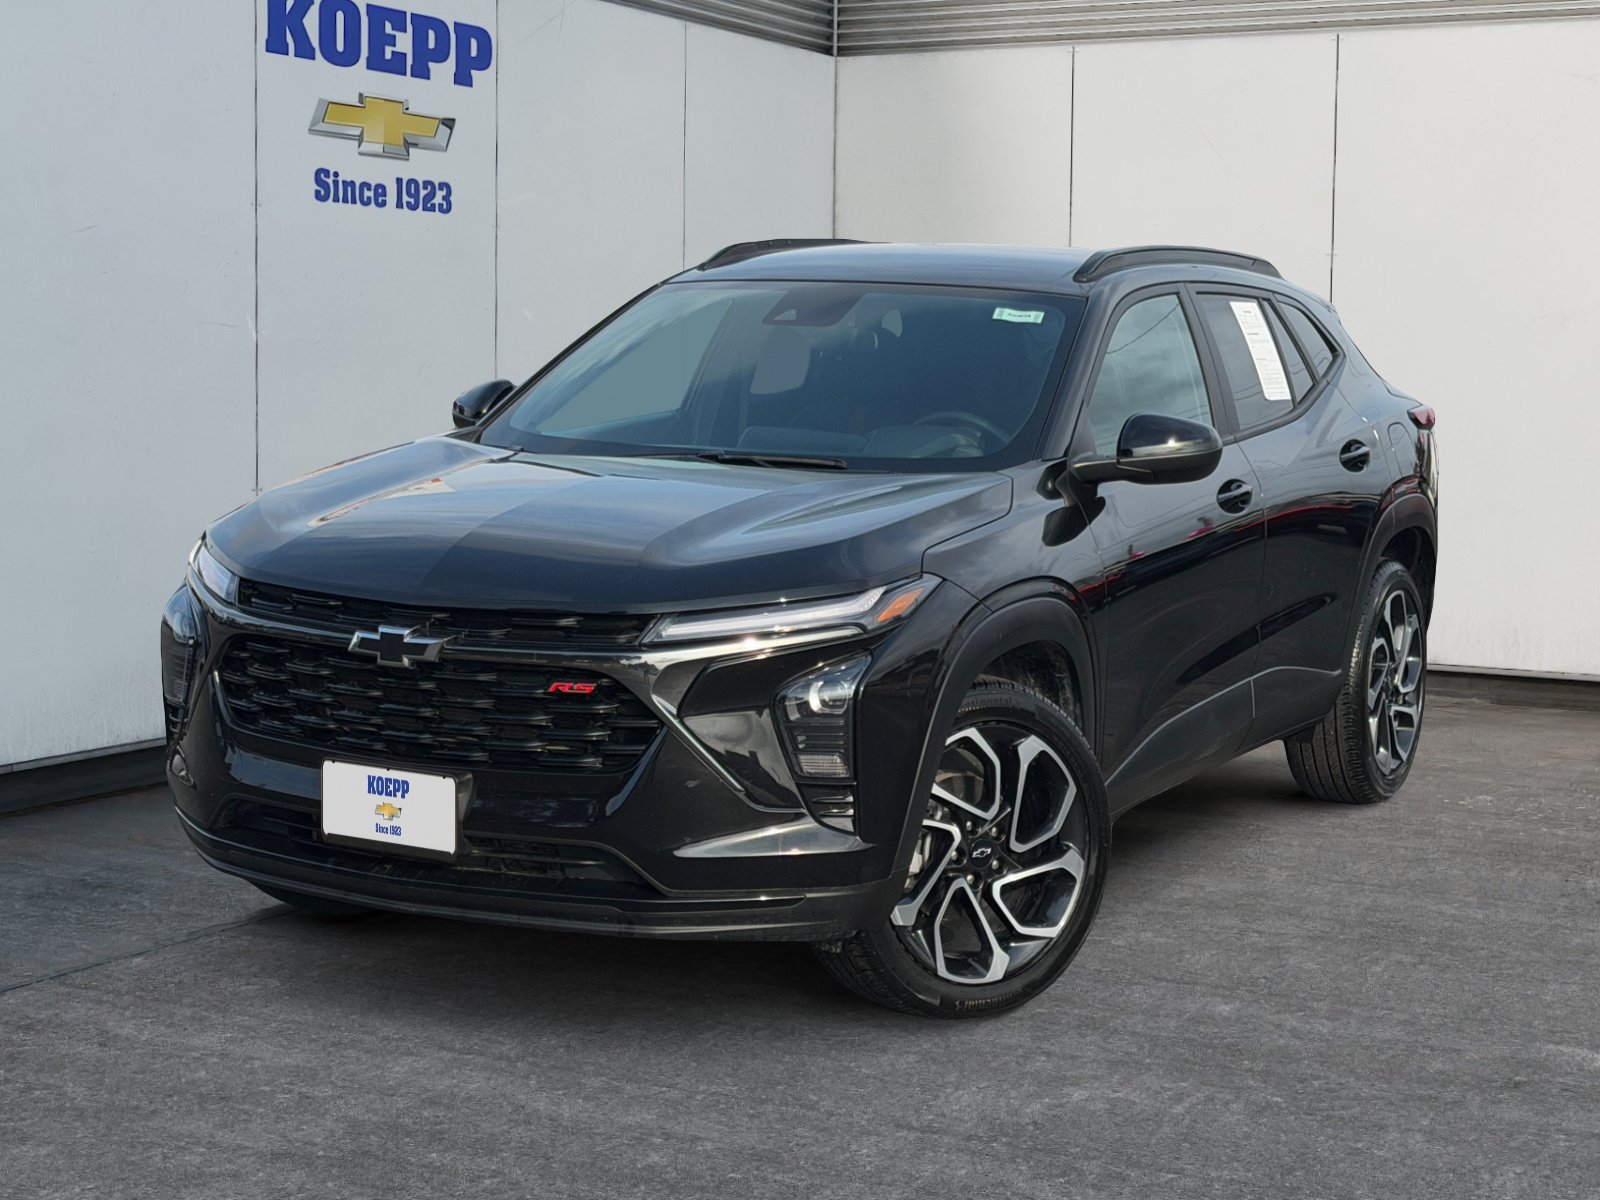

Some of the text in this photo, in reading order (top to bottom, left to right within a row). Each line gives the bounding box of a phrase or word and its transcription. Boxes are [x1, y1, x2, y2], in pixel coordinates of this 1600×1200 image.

[265, 0, 493, 88] KOEPP
[314, 167, 453, 215] Since 1923
[548, 682, 597, 694] RS
[367, 774, 410, 799] KOEPP
[375, 822, 388, 834] Since
